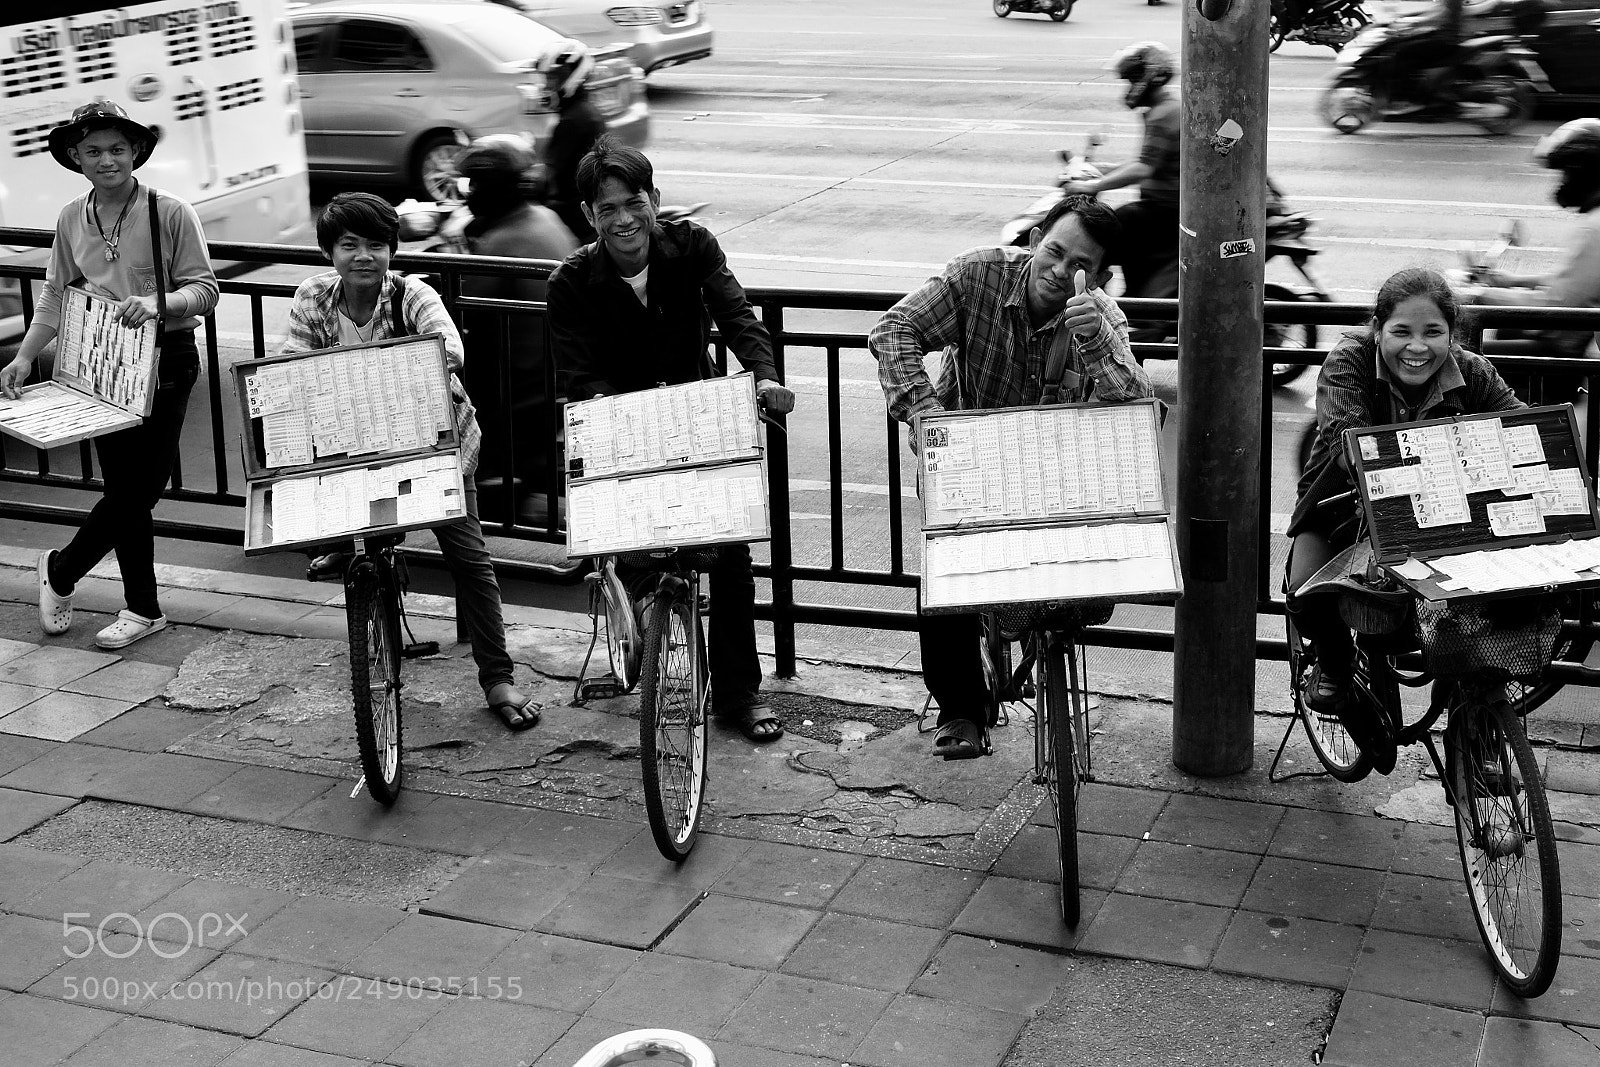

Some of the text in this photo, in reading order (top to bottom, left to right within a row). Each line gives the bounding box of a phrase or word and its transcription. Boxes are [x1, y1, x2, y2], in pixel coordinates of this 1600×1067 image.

[251, 407, 261, 415] 30
[927, 428, 937, 437] 10
[1452, 425, 1460, 435] 2
[1401, 432, 1409, 443] 2
[1455, 436, 1463, 447] 2
[927, 451, 936, 460] 10
[1405, 446, 1413, 456] 2
[1369, 473, 1381, 483] 10
[1370, 485, 1385, 495] 60
[1417, 503, 1425, 514] 2
